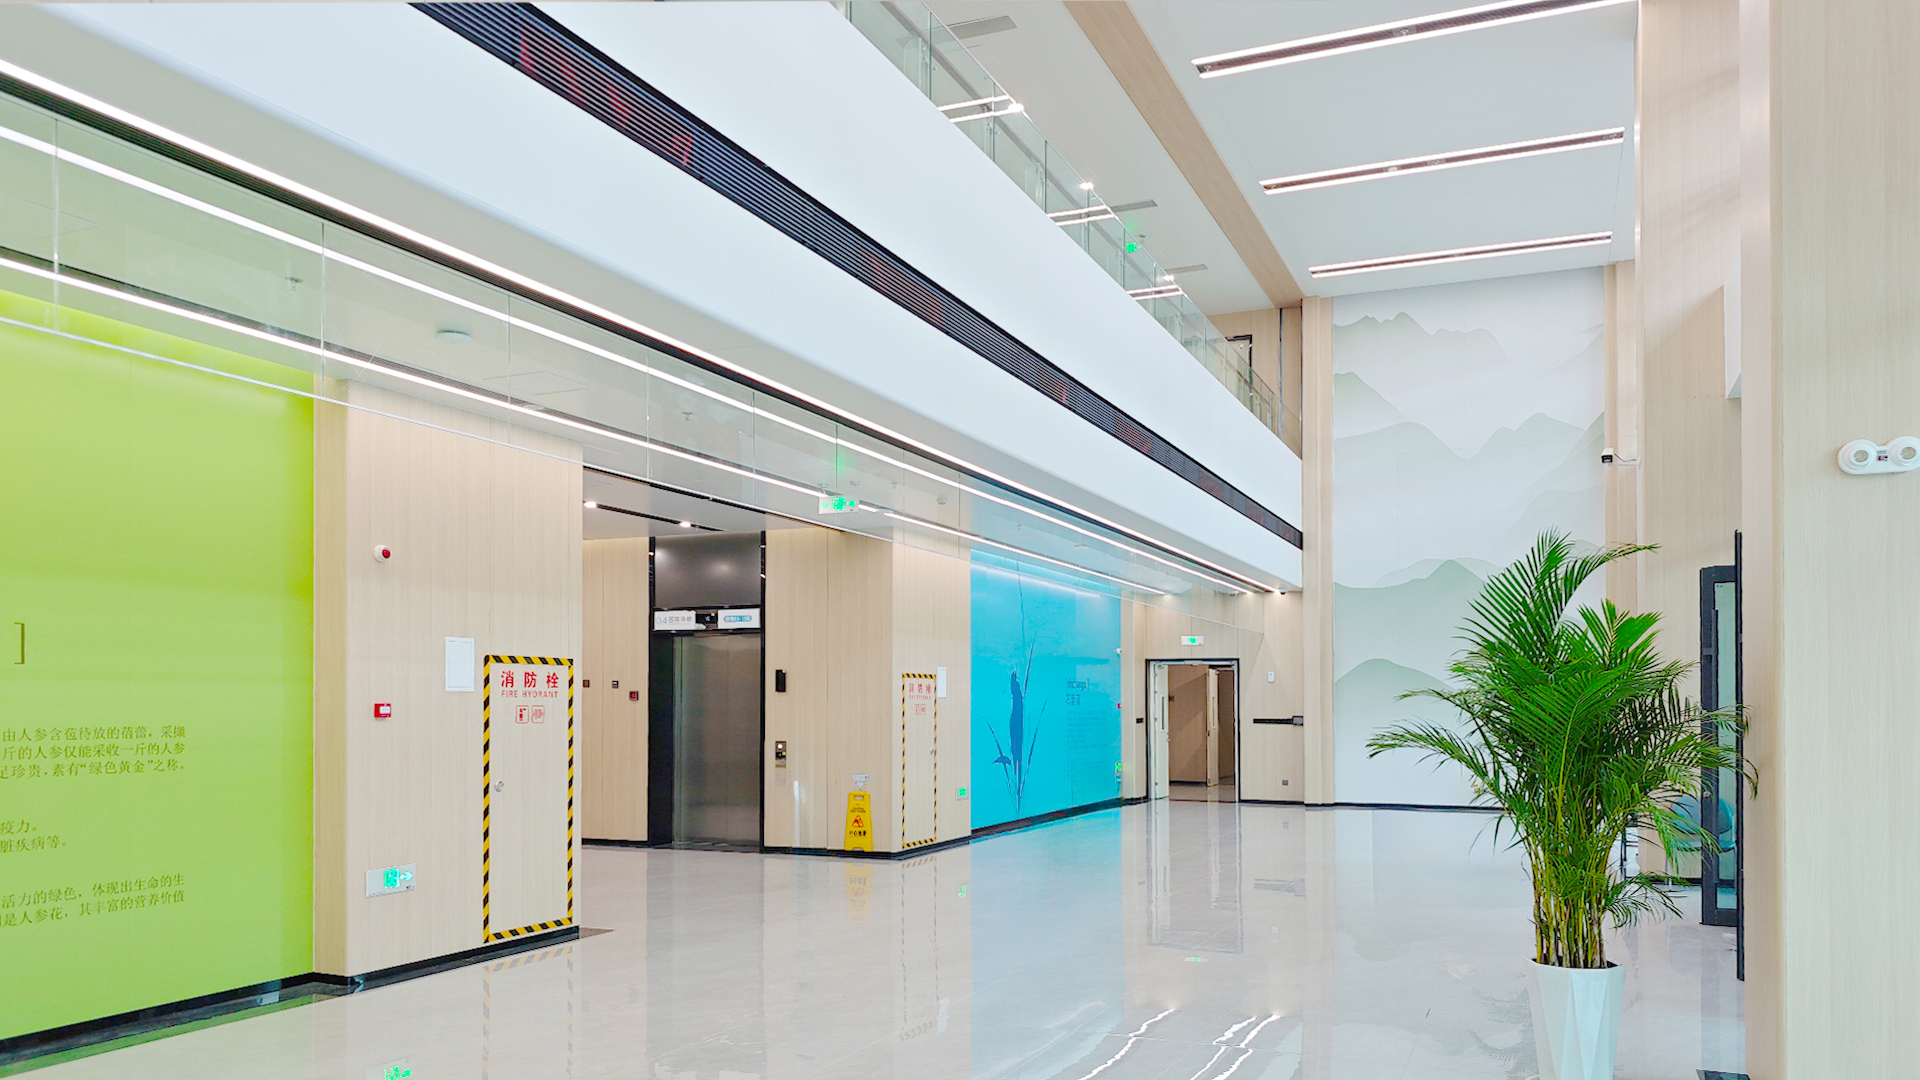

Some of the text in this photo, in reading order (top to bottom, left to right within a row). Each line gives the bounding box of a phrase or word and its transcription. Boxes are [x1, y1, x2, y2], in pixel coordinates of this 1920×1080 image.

[501, 670, 559, 689] 消防栓
[501, 690, 558, 698] FIRE HYDRANT
[0, 889, 185, 928] 是人参花，其丰富的营养价值
